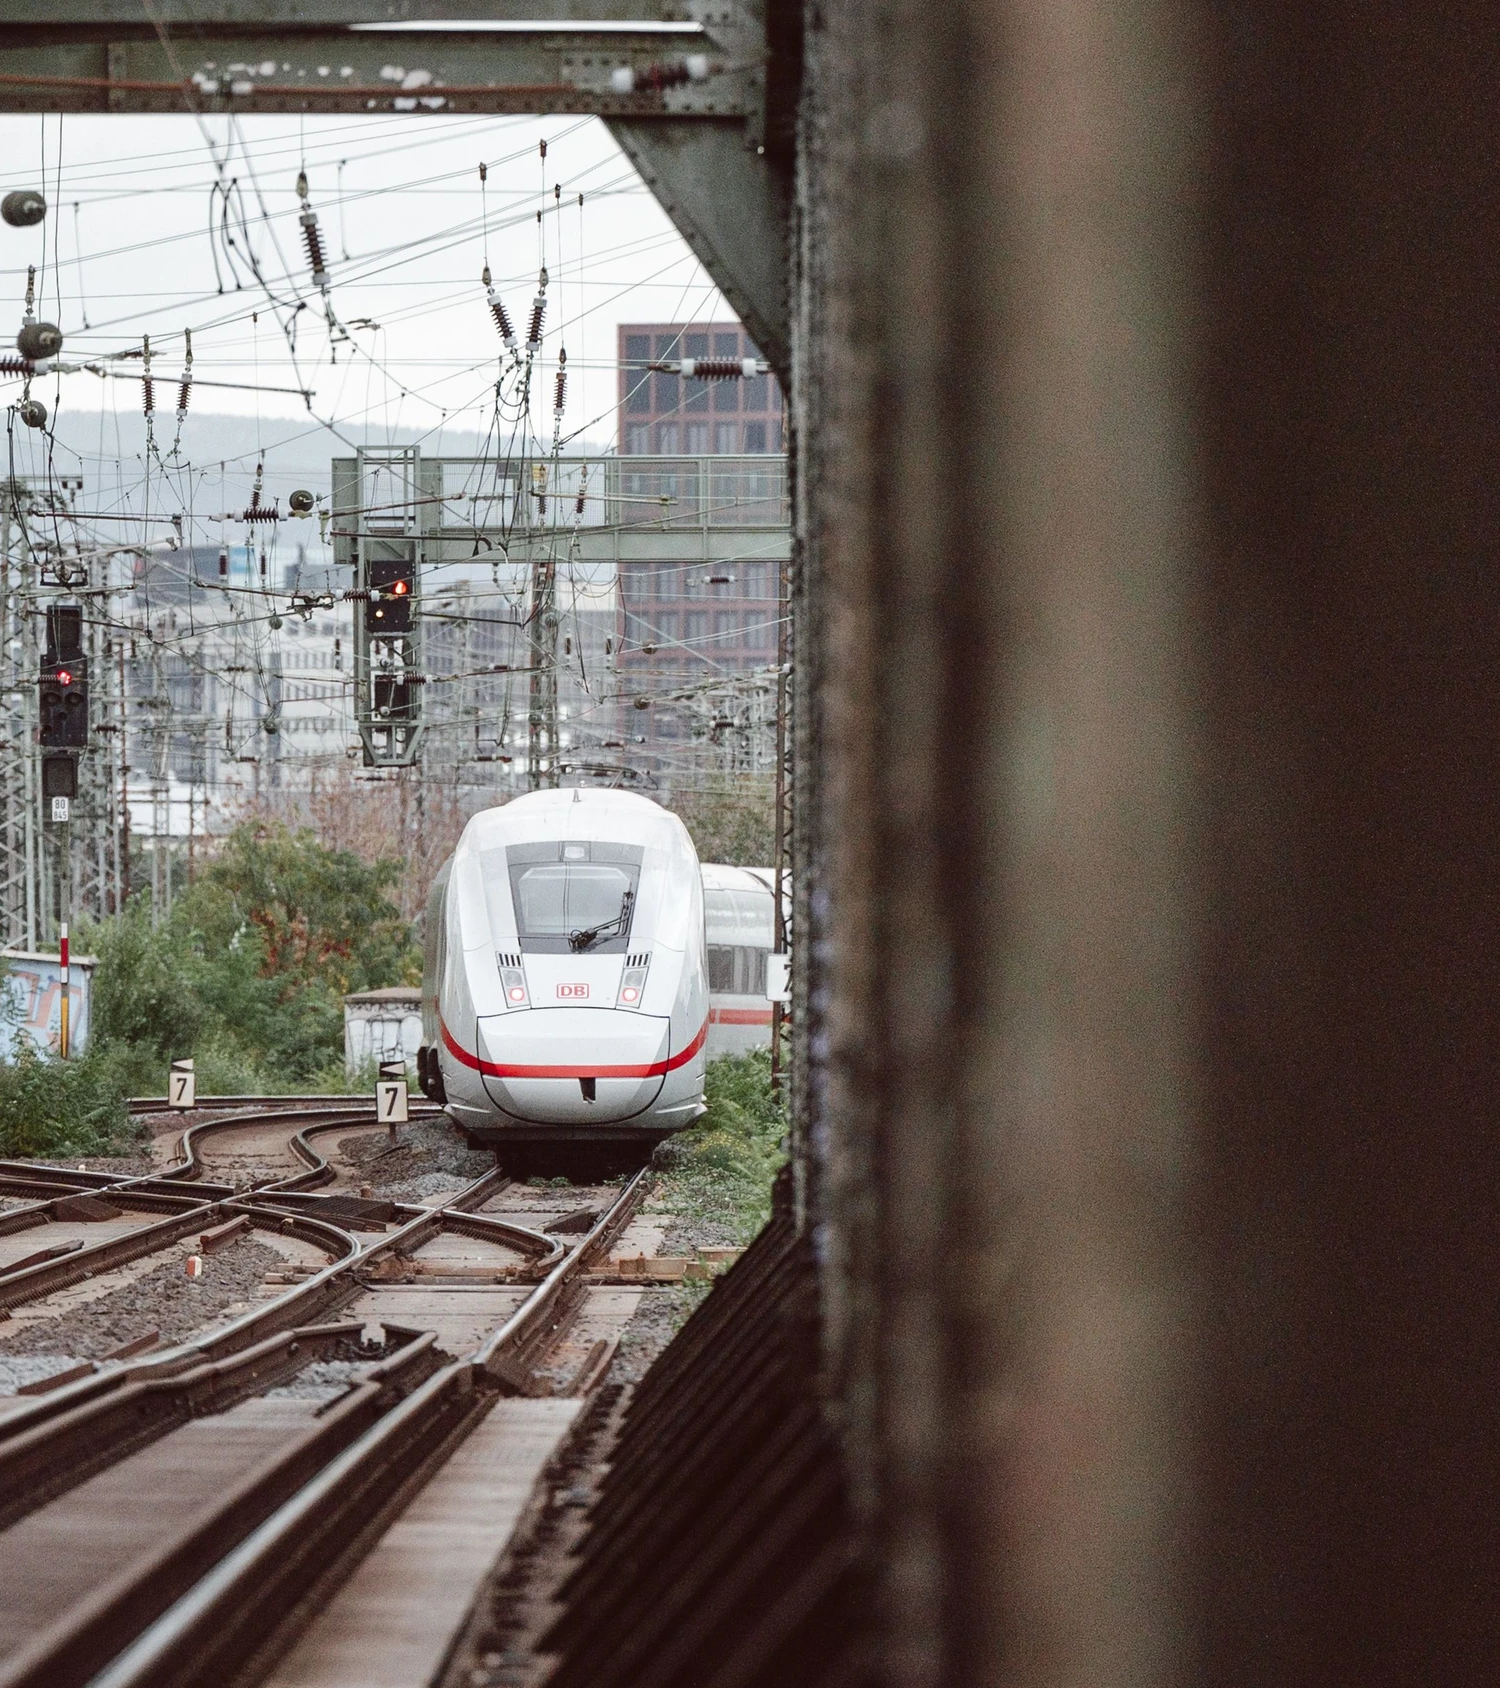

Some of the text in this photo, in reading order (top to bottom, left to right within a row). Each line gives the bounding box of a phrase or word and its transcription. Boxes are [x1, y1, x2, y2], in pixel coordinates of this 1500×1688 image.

[55, 799, 66, 809] 80
[560, 985, 586, 997] DB
[177, 1077, 187, 1102] 7
[385, 1087, 399, 1117] 7
